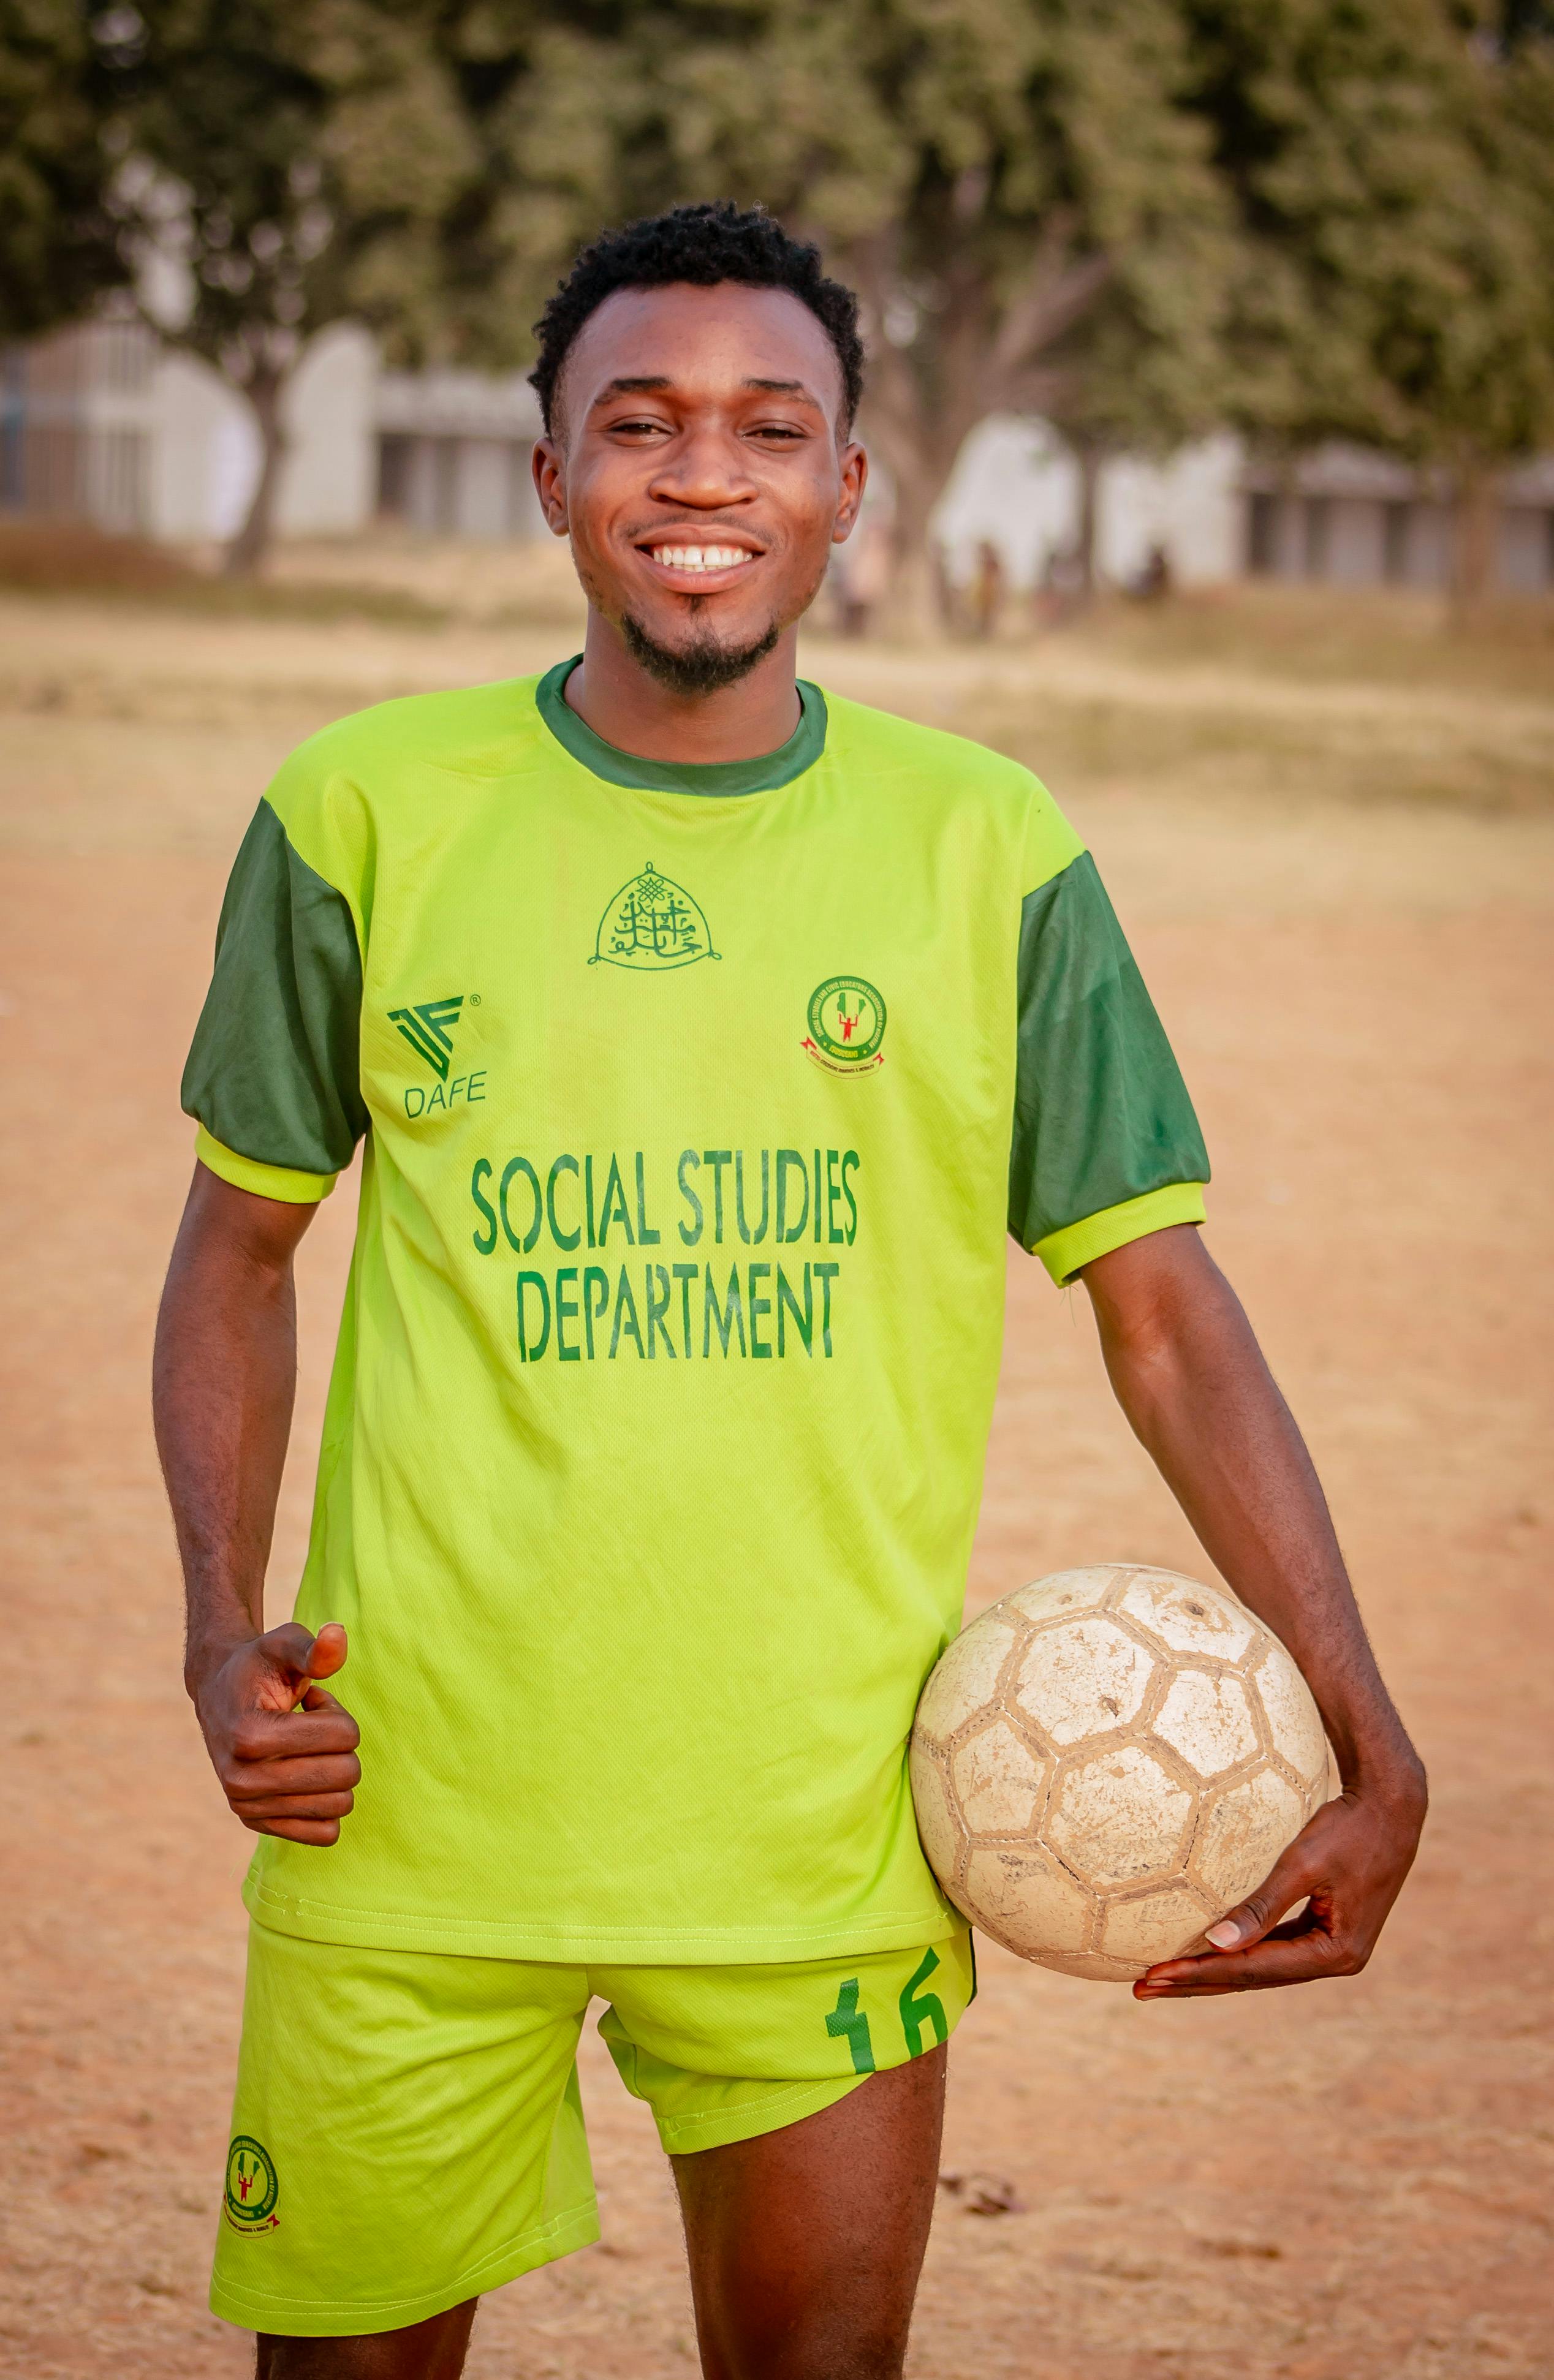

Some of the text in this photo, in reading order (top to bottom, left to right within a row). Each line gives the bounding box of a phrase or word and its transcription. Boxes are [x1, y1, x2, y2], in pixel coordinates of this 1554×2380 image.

[404, 1071, 487, 1119] DAFE
[471, 1149, 860, 1256] SOCIAL STUDIES
[517, 1261, 840, 1363] DEPARTMENT
